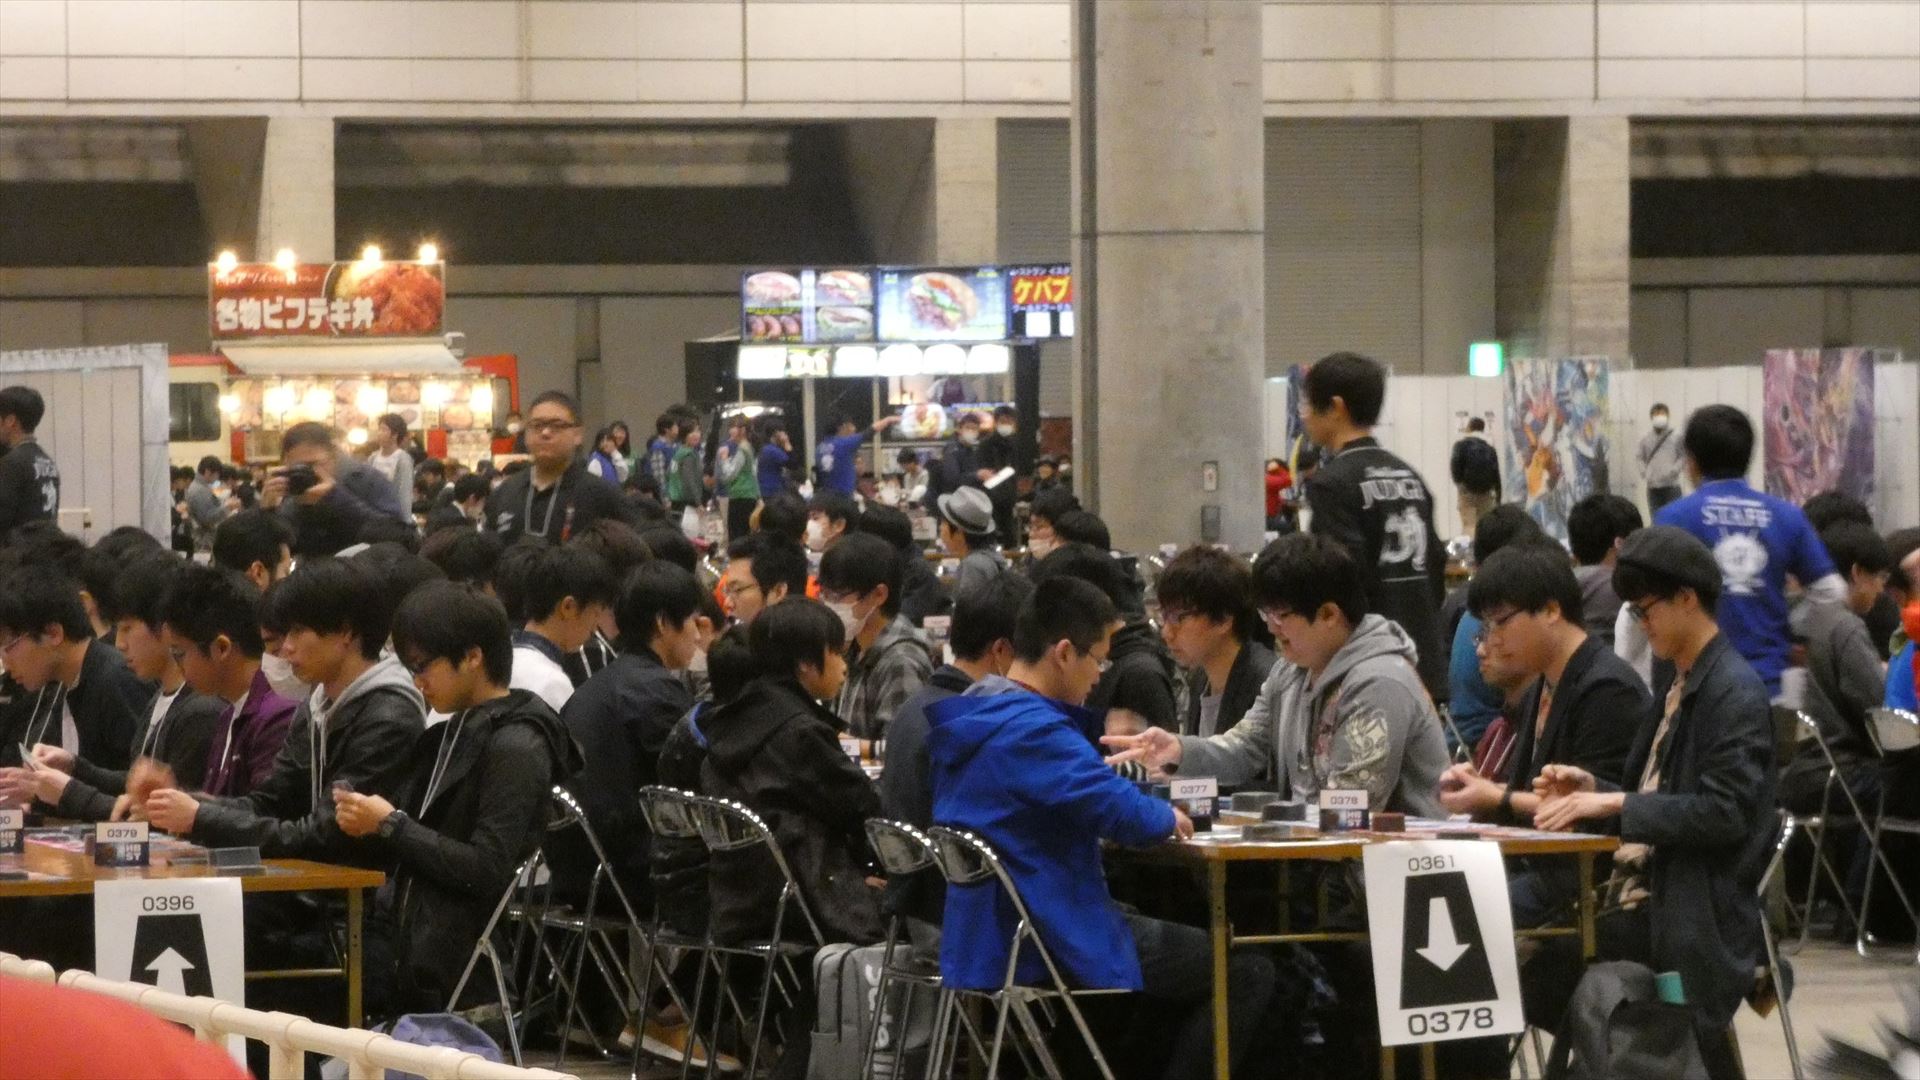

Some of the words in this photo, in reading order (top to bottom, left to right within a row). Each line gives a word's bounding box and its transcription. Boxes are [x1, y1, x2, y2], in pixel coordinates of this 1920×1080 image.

[216, 297, 374, 331] 名物ビフテキ丼
[1701, 506, 1772, 528] STAFF
[1180, 785, 1207, 795] 0377
[1330, 796, 1359, 805] 0378
[107, 828, 138, 838] 0379
[1408, 855, 1456, 872] 0361
[142, 895, 195, 912] 0396
[1408, 1007, 1494, 1036] 0378
